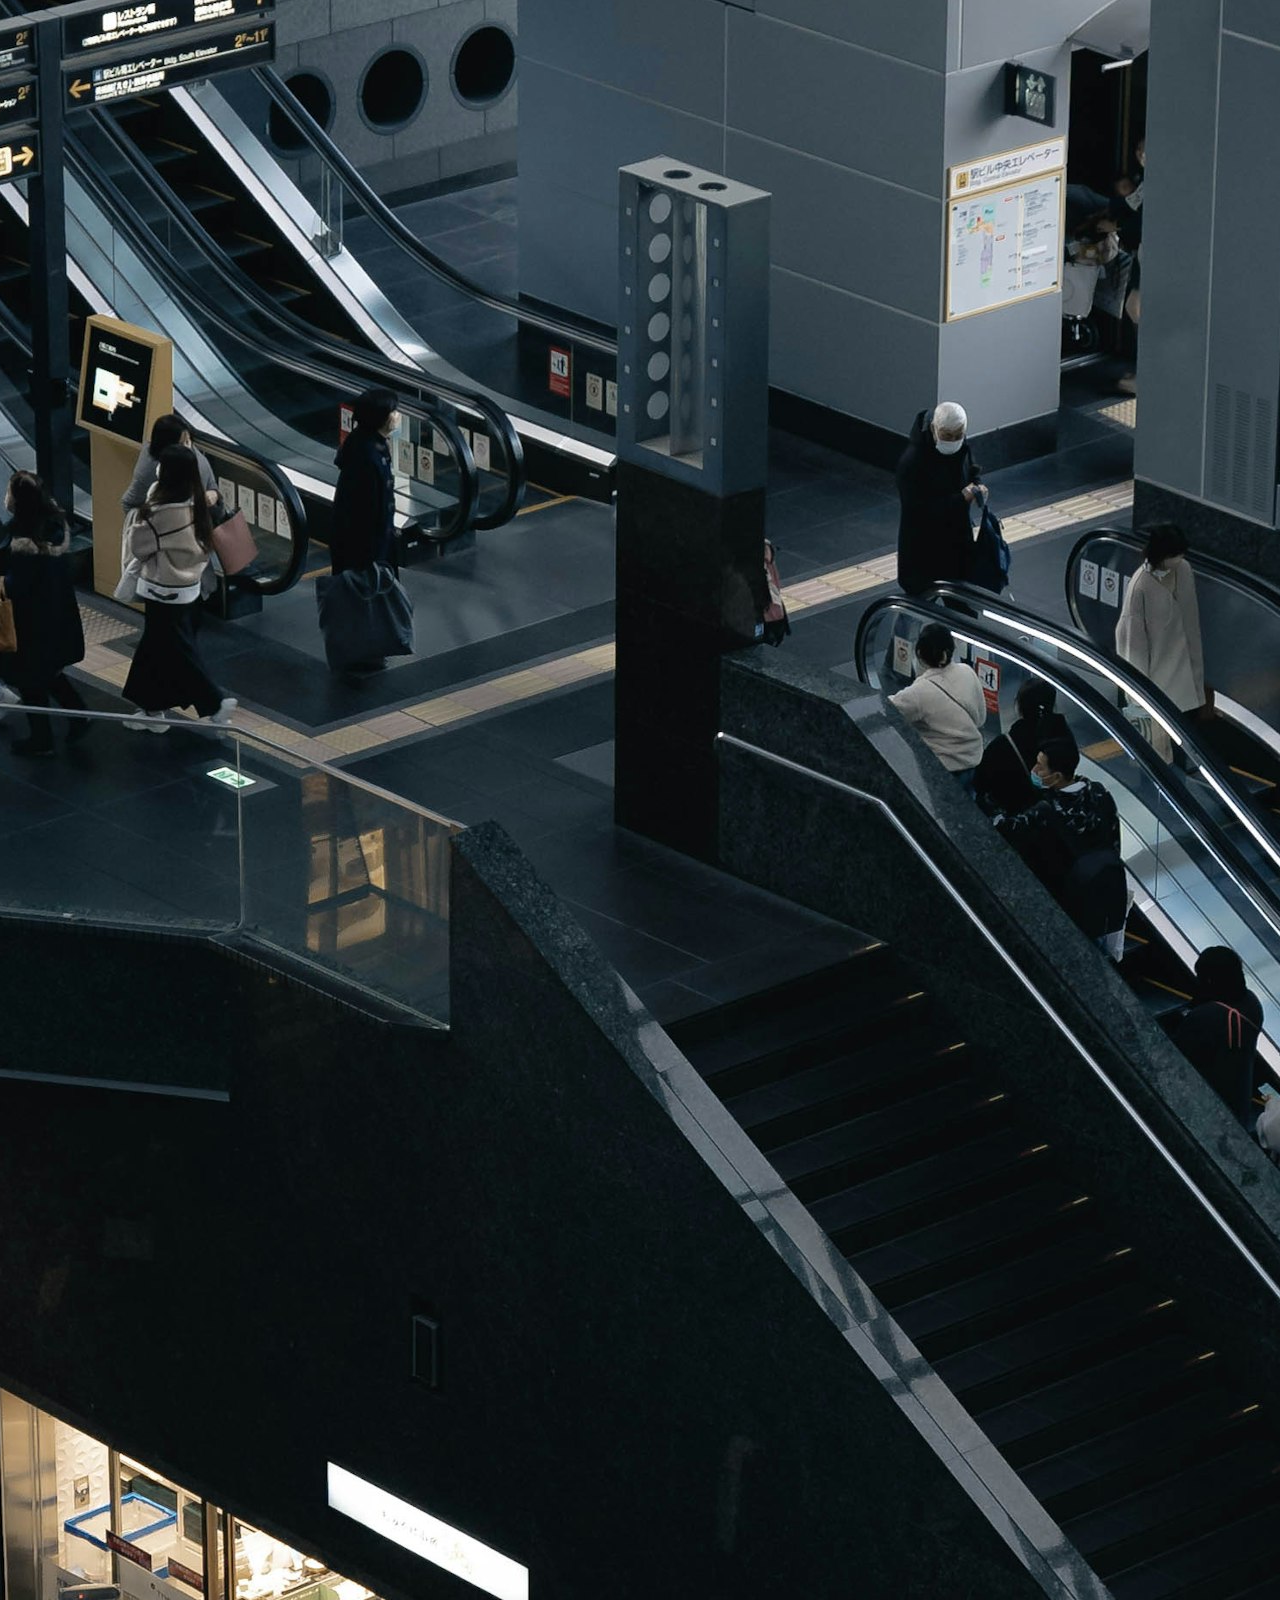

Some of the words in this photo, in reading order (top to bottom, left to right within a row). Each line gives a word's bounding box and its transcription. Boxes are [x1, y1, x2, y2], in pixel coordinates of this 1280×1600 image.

[16, 31, 29, 46] 2F
[18, 85, 31, 100] 2F
[970, 148, 1060, 180] 駅ビル中央エレベーター
